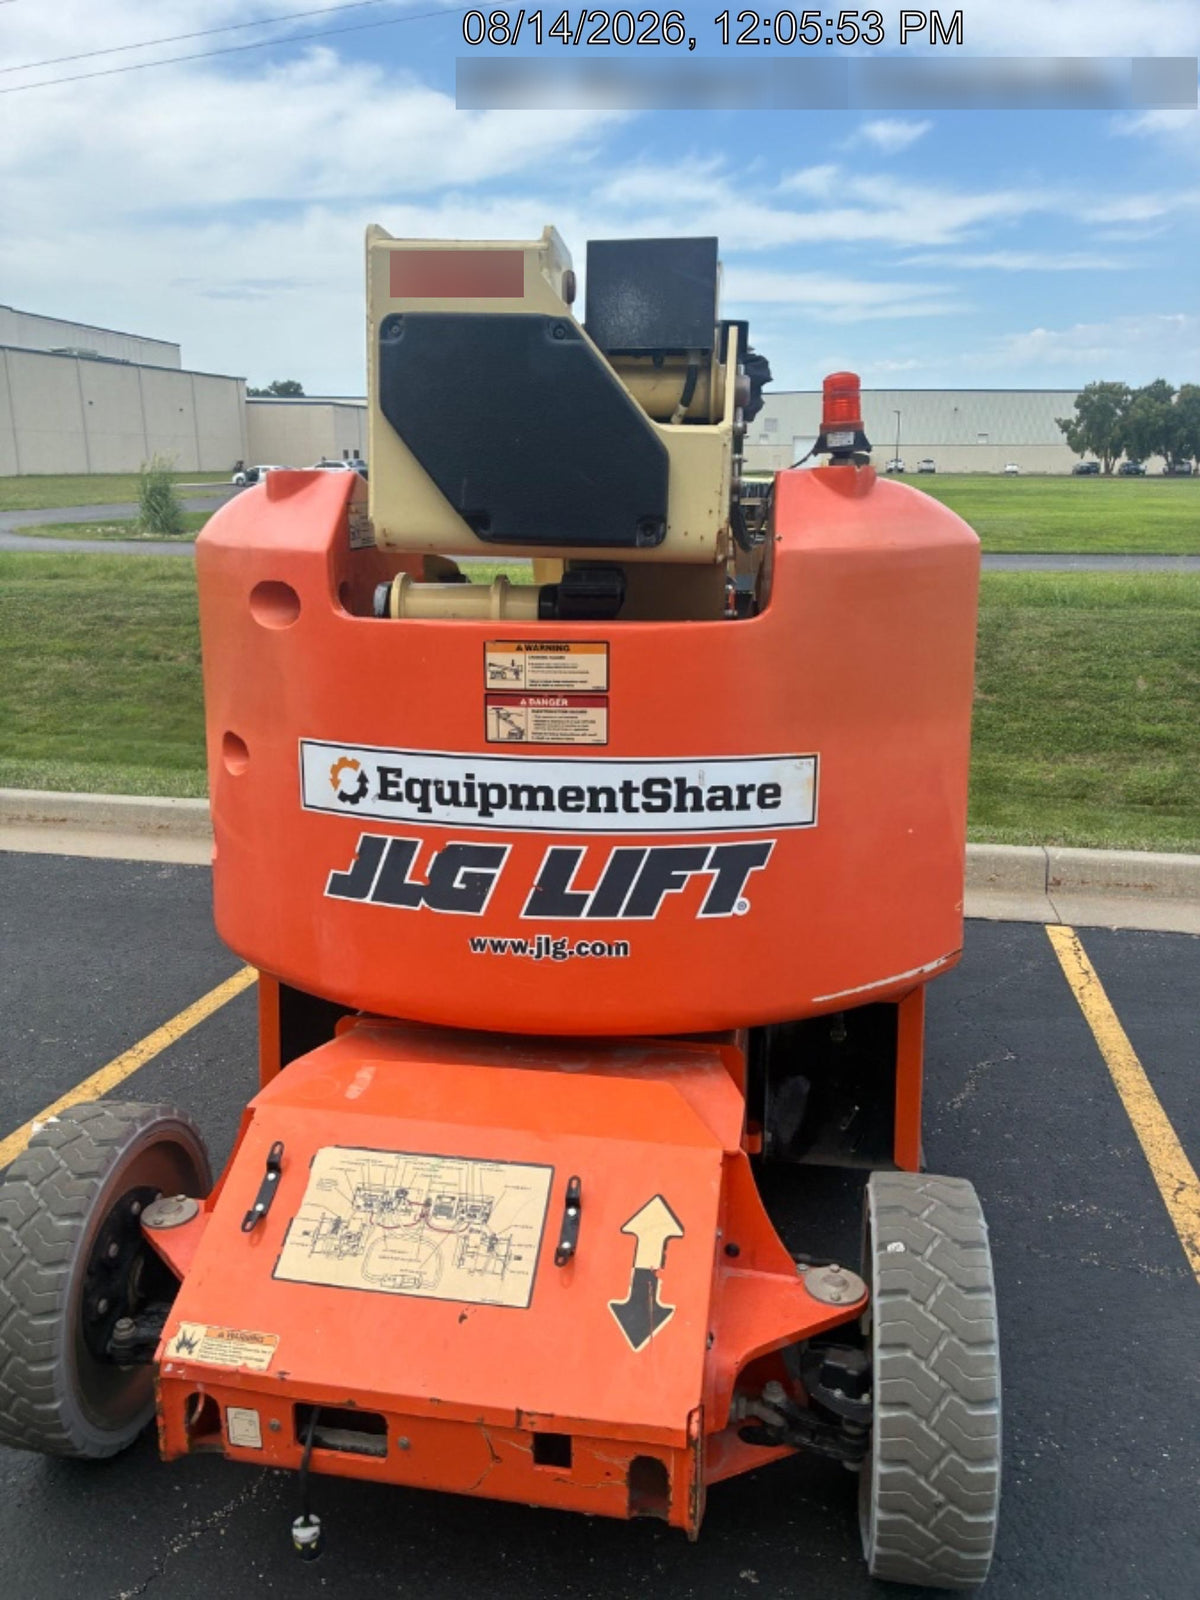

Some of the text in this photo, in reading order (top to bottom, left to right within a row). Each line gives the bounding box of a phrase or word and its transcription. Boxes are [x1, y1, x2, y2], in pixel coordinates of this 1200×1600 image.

[525, 644, 570, 652] WARNING
[528, 698, 568, 706] DANGER
[376, 766, 782, 818] EquipmentShare
[324, 832, 777, 919] JLG LIFT
[469, 934, 630, 962] www.jlg.com
